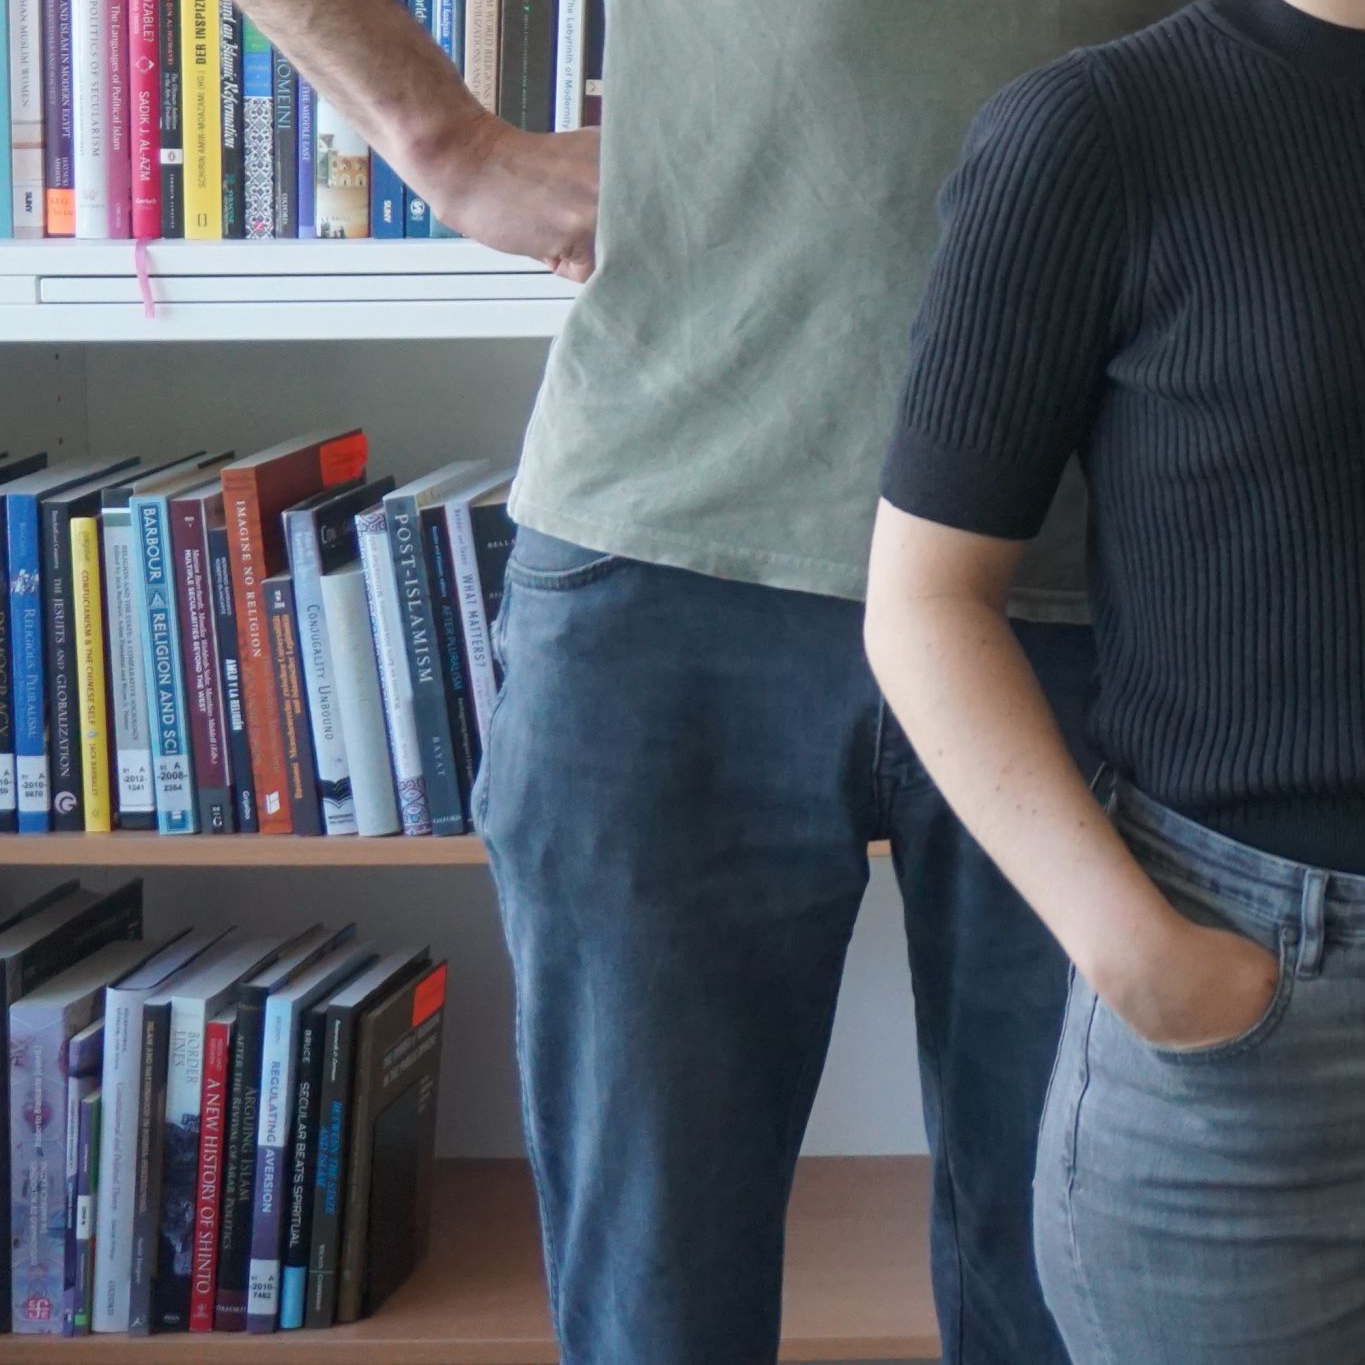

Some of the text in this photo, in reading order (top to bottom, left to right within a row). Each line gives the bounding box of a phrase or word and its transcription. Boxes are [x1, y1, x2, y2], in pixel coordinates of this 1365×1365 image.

[108, 23, 121, 72] Languages
[110, 4, 121, 21] The
[195, 43, 207, 65] DER
[111, 73, 121, 84] of
[111, 85, 122, 123] Political
[138, 90, 150, 181] SADIK J. AL-AZM
[111, 125, 122, 150] Islam
[142, 507, 174, 724] BARBOUR RELIGION AND
[235, 499, 261, 657] IMAGINE NO RELIGION
[393, 512, 434, 683] POST-ISLAMISM
[461, 573, 487, 668] WHAT MATTERS?
[53, 578, 70, 777] THE JESUITS AND GLOBALIZATION
[305, 603, 337, 741] CONJUGALITY UNBOUND
[196, 1078, 220, 1293] A NEW HISTORY OF SHINTO
[262, 1060, 280, 1213] REGULATING AVERSION
[289, 1029, 311, 1248] BRUCE SECULAR BEATS SPIRITUAL
